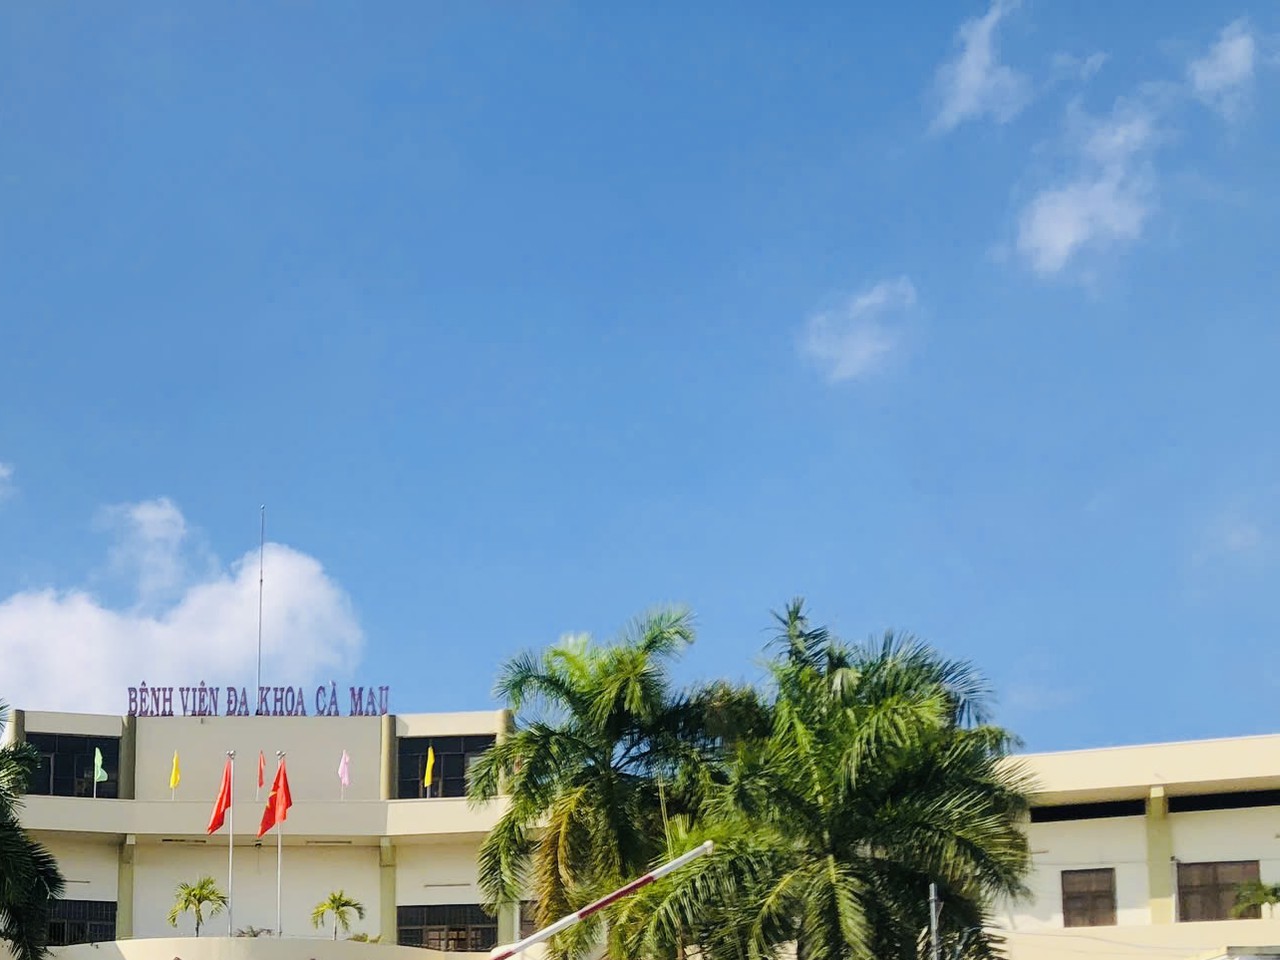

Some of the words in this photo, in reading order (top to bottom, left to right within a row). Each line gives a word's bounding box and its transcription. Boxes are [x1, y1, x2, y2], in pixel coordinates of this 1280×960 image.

[226, 687, 249, 716] ĐA
[257, 686, 306, 716] KHOA
[315, 681, 339, 716] CÀ
[350, 686, 389, 716] MAU
